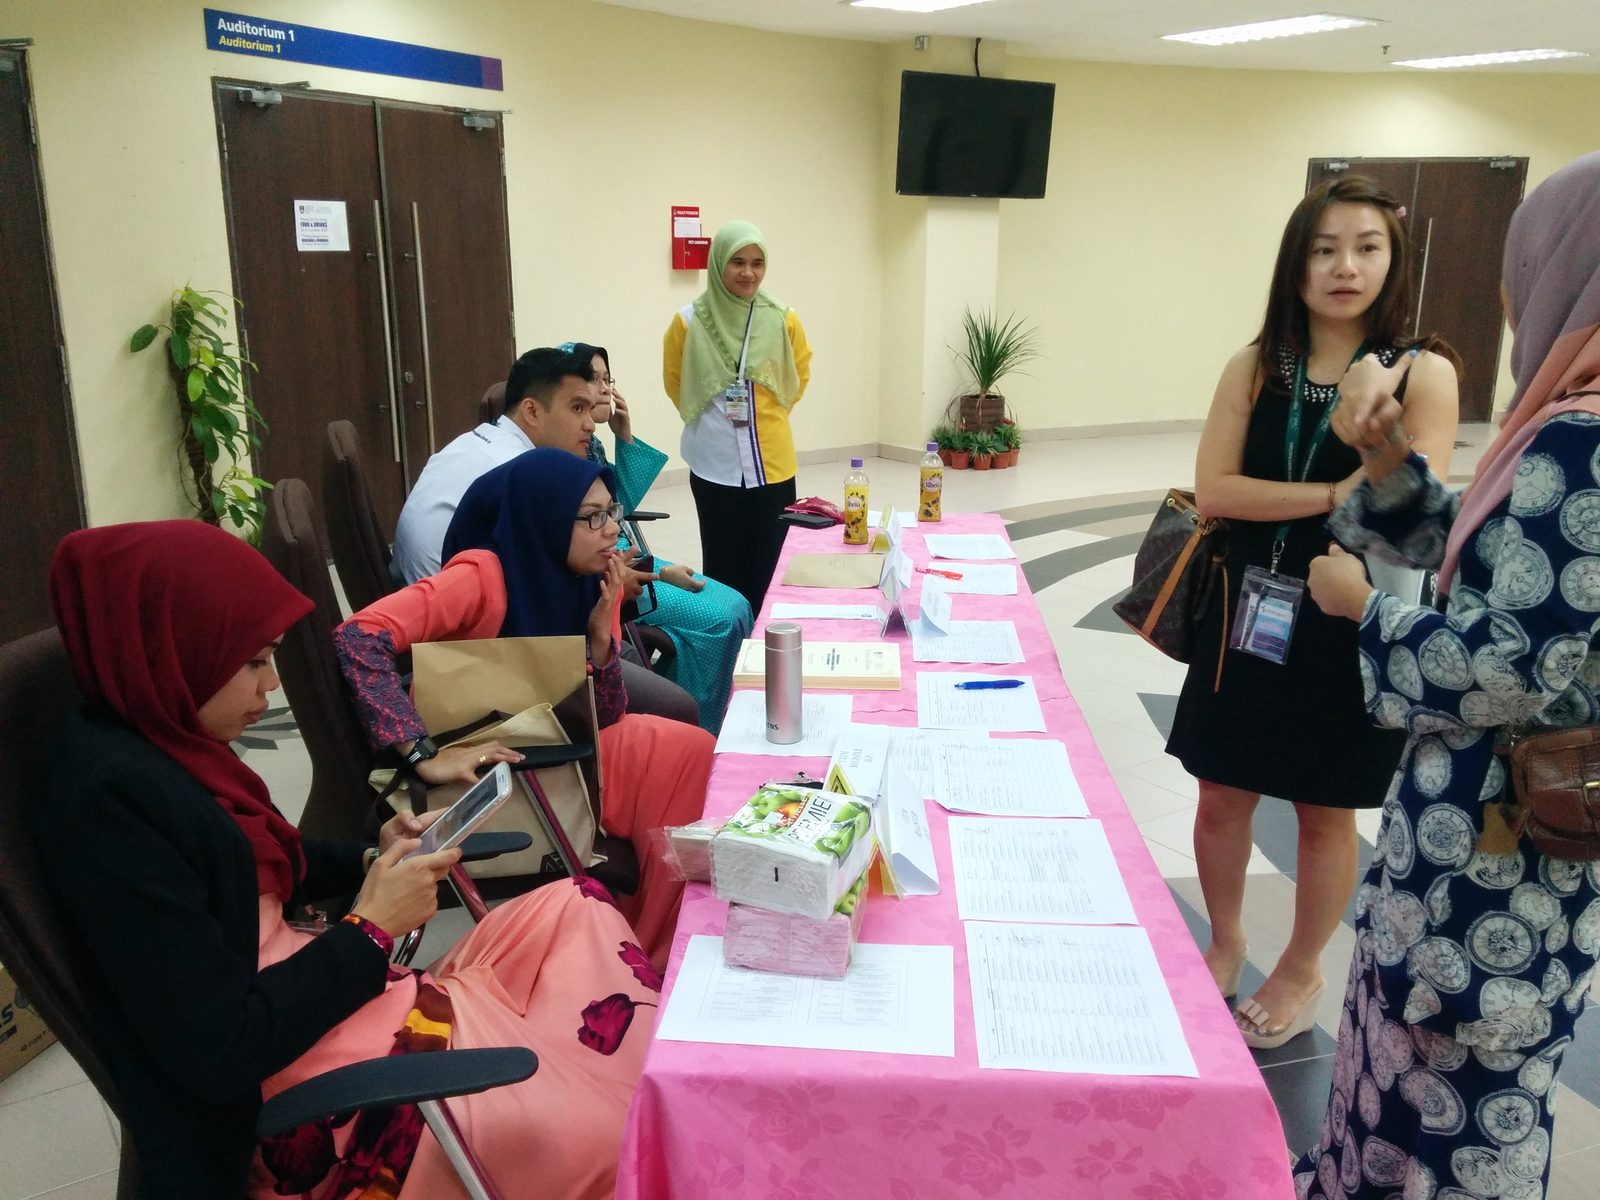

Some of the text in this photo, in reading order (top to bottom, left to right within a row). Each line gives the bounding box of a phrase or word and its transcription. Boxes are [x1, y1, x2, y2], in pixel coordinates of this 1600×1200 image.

[217, 18, 295, 42] Auditorium 1
[218, 35, 281, 53] Auditorium 1
